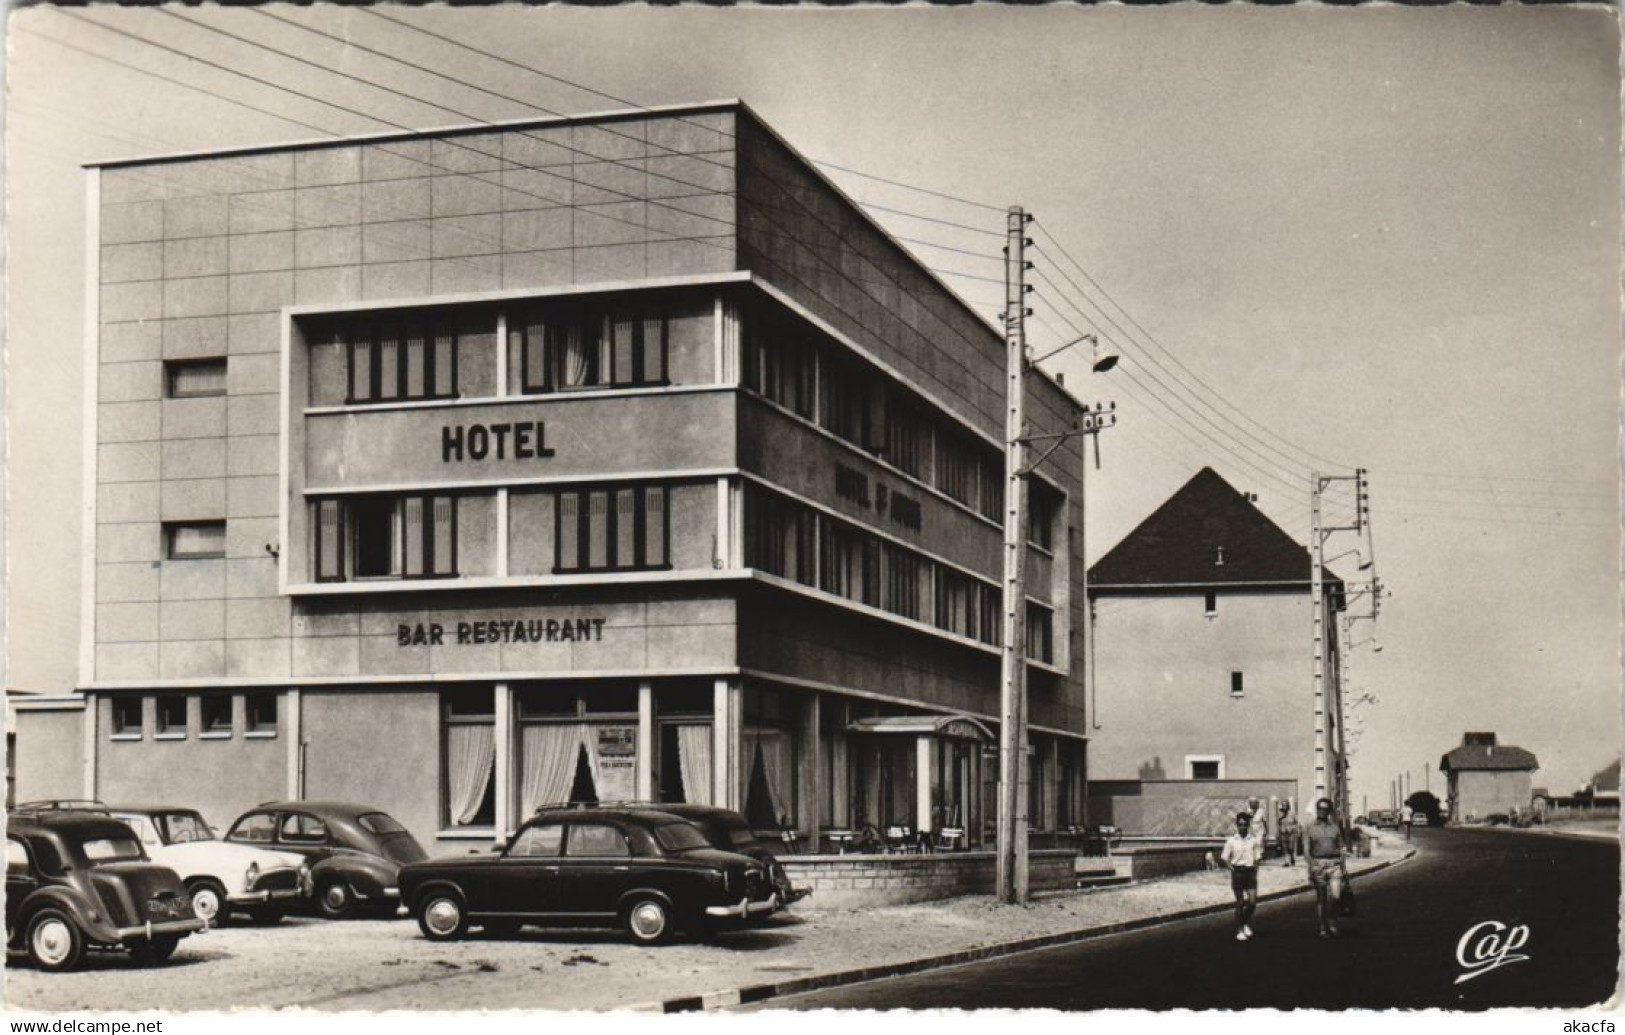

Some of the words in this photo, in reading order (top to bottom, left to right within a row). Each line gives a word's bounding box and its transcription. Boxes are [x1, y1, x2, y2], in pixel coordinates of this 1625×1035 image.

[441, 421, 556, 463] HOTEL
[397, 621, 444, 646] BAR
[457, 618, 607, 645] RESTAURANT
